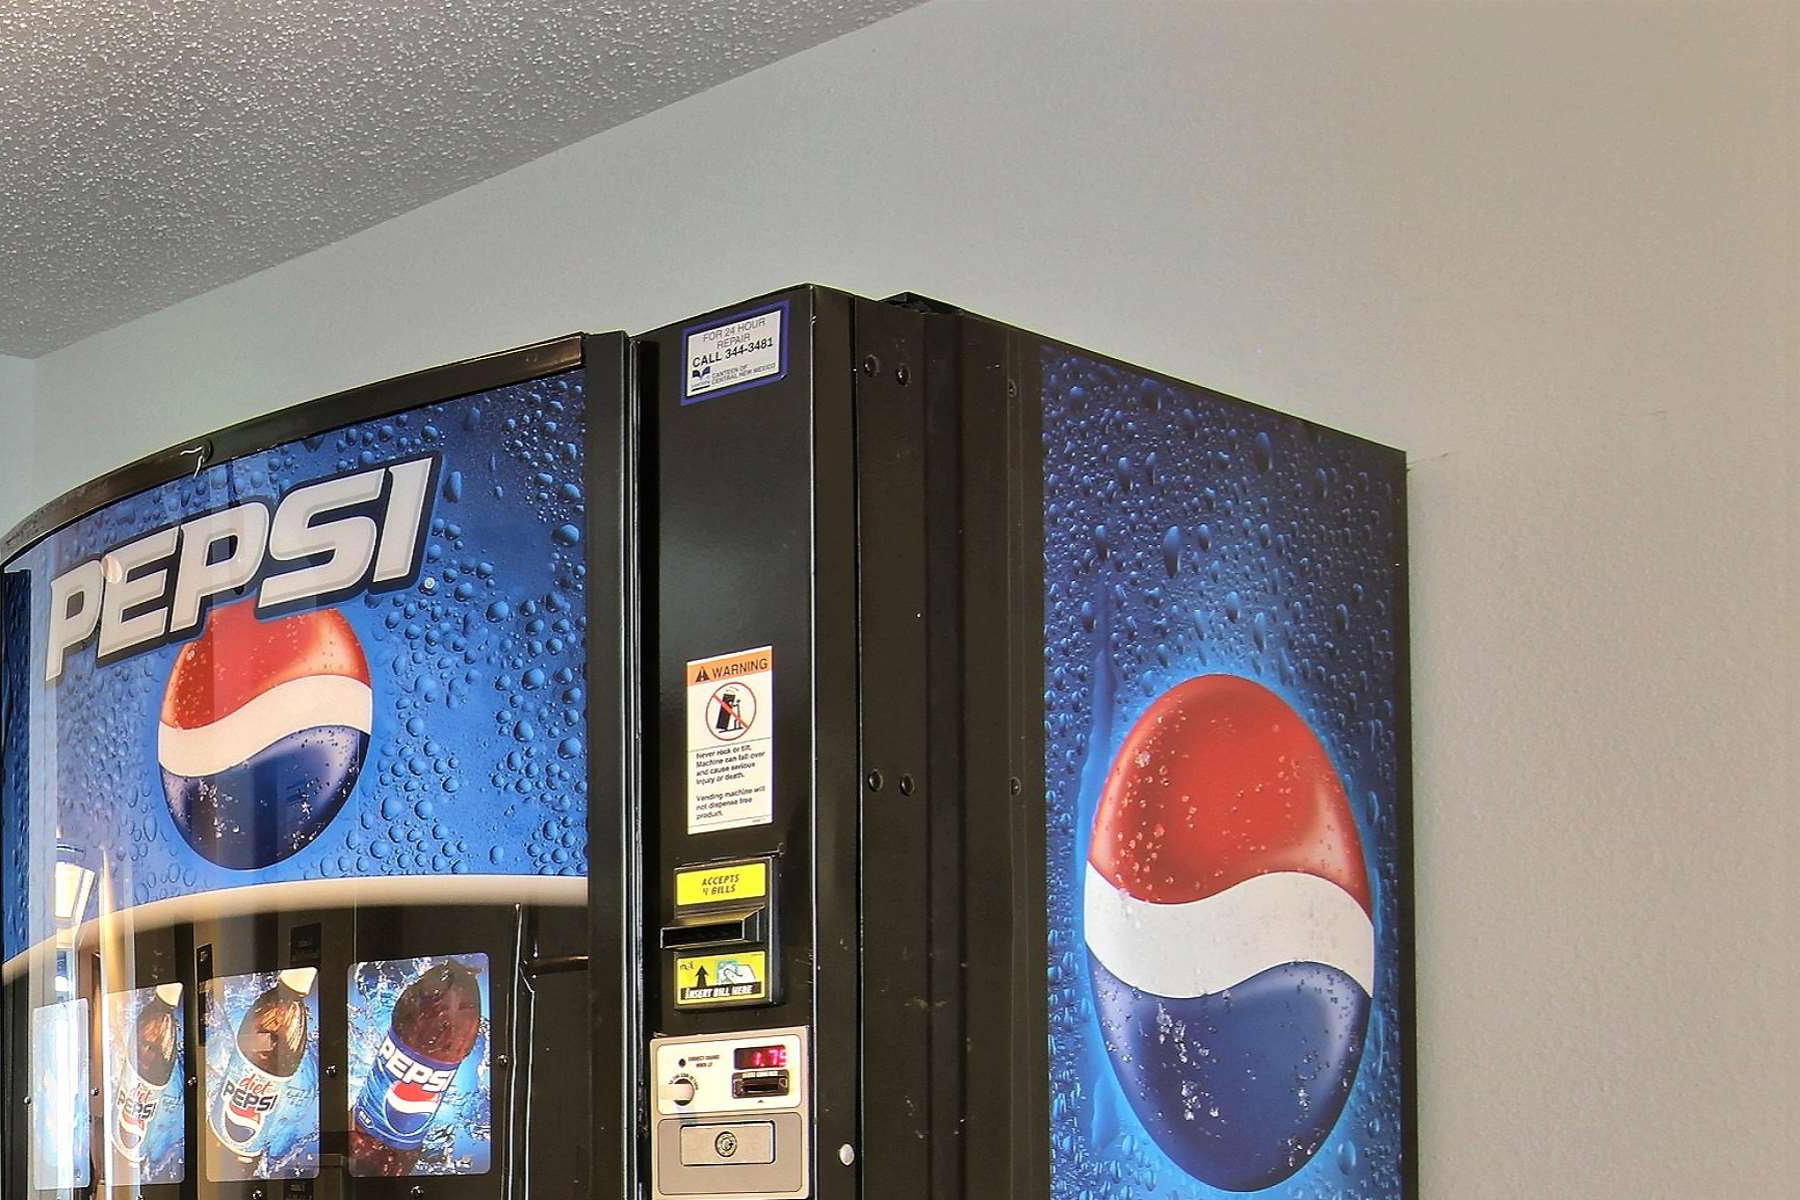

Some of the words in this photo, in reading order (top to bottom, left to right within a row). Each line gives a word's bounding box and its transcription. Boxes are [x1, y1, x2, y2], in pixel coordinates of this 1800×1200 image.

[703, 330, 722, 342] FOR
[725, 327, 736, 337] 24
[737, 318, 766, 332] HOUR
[716, 333, 751, 349] REPAIR
[692, 352, 722, 367] CALL
[725, 337, 774, 359] 344-3481
[46, 455, 437, 682] PEPSI
[712, 658, 768, 681] WARNING
[701, 874, 739, 886] ACCEPTS
[686, 988, 712, 999] INSERT
[713, 987, 730, 997] BILL
[732, 985, 753, 995] HERE
[378, 1037, 457, 1093] PEPSI
[222, 1080, 277, 1113] PEPSI
[241, 1074, 274, 1096] diet
[117, 1090, 157, 1119] PEPSI
